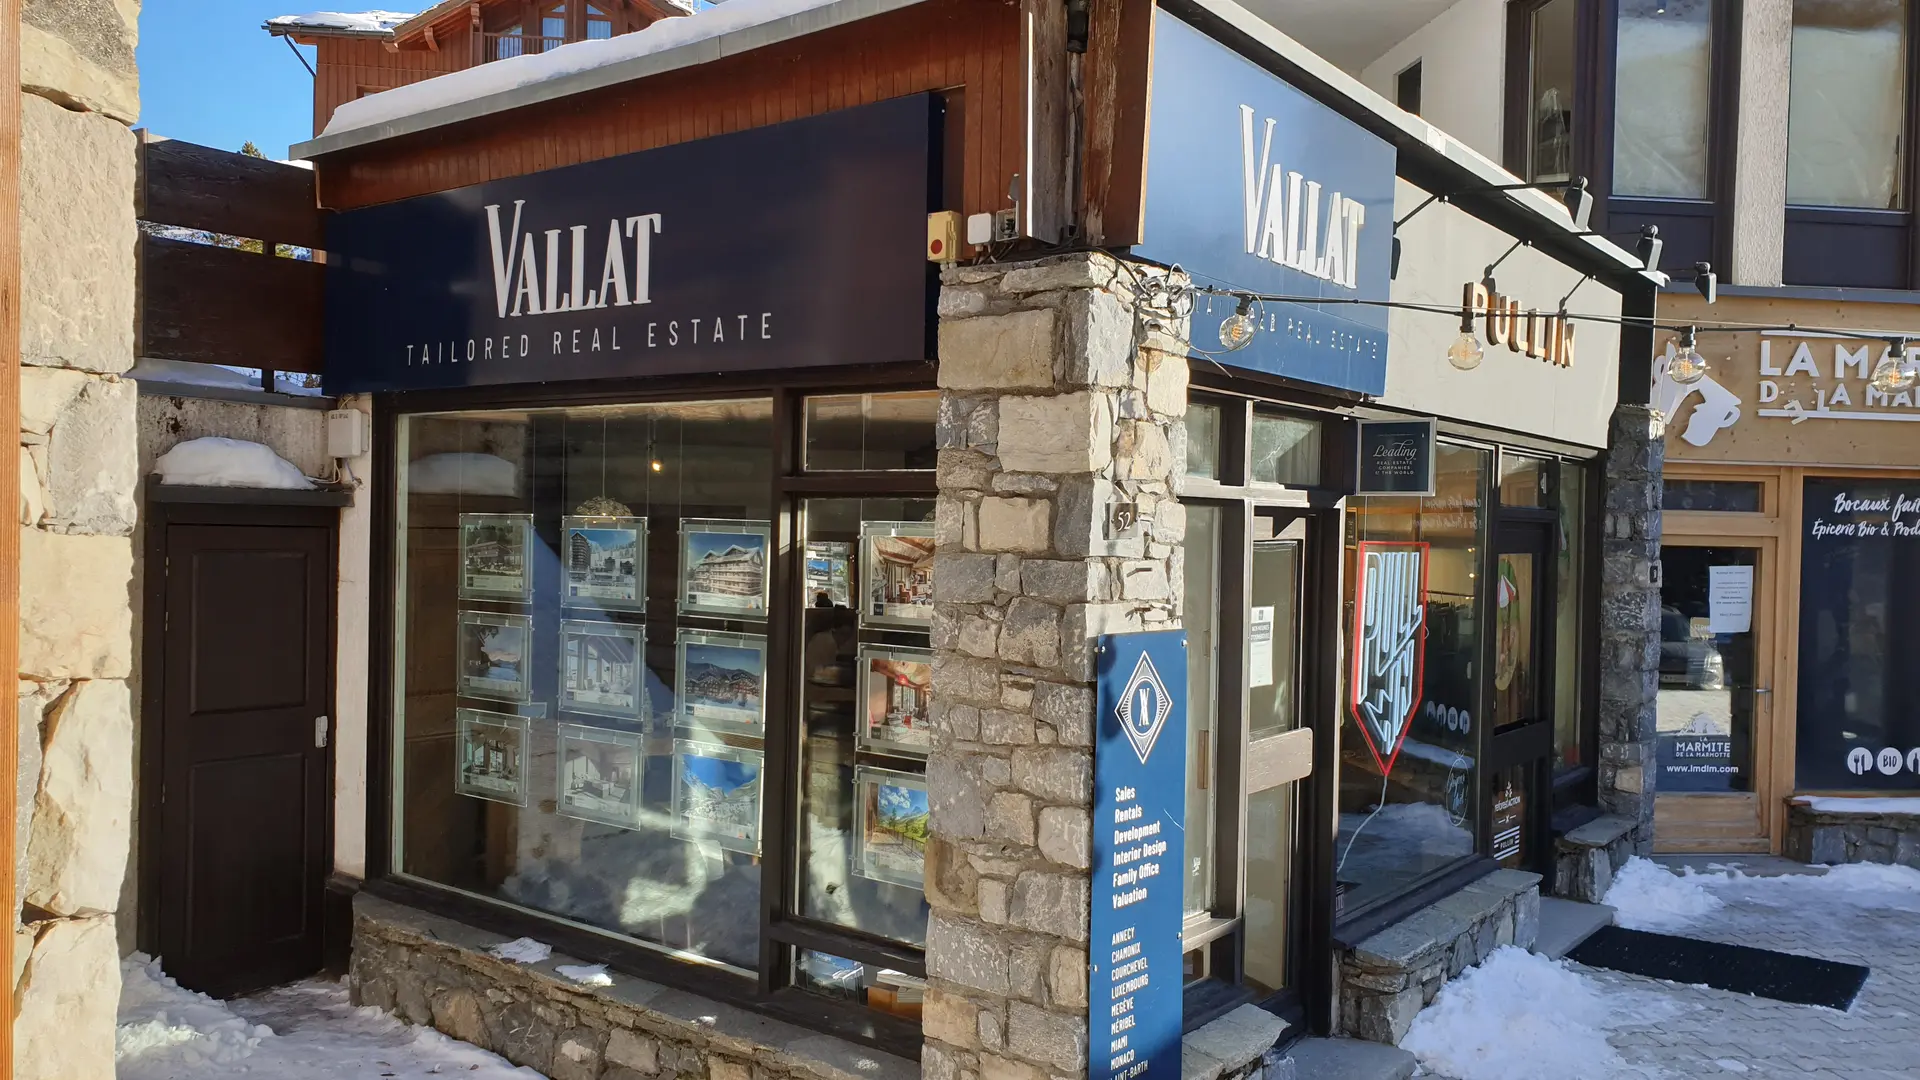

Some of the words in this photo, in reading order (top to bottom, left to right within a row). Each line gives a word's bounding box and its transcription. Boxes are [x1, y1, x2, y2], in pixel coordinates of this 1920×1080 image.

[1239, 104, 1365, 289] VALLAT
[484, 199, 661, 318] VALLAT
[407, 334, 530, 366] TAILORED
[553, 326, 621, 355] REAL
[647, 312, 772, 348] ESTATE
[1759, 340, 1820, 378] LA
[1815, 383, 1851, 412] LA
[1373, 439, 1417, 461] Leading
[1833, 492, 1891, 514] Bocaux
[1117, 511, 1131, 532] 52
[1812, 517, 1856, 540] Épicerie
[1857, 521, 1878, 537] Bio
[1880, 521, 1890, 536] &
[1676, 742, 1731, 752] MARMITE
[1666, 764, 1739, 774] www.lmdlm.com
[1882, 755, 1898, 768] BIO
[1115, 786, 1136, 802] Sales
[1115, 804, 1143, 823] Rentals
[1114, 820, 1161, 845] Development
[1113, 846, 1142, 866] Interior
[1143, 840, 1167, 857] Design
[1112, 868, 1138, 888] Family
[1138, 862, 1160, 880] Office
[1112, 887, 1147, 909] Valuation
[1111, 926, 1135, 946] ANNECY
[1111, 941, 1141, 964] CHAMONIX
[1111, 957, 1148, 981] COURCHEVEL
[1111, 973, 1149, 999] LUXEMBOURG
[1111, 996, 1134, 1017] MEGÈVE
[1111, 1014, 1136, 1035] MÉRIBEL
[1110, 1034, 1128, 1053] MIAMI
[1108, 1059, 1149, 1080] AINT-BARTH
[1110, 1048, 1135, 1071] MONACO
